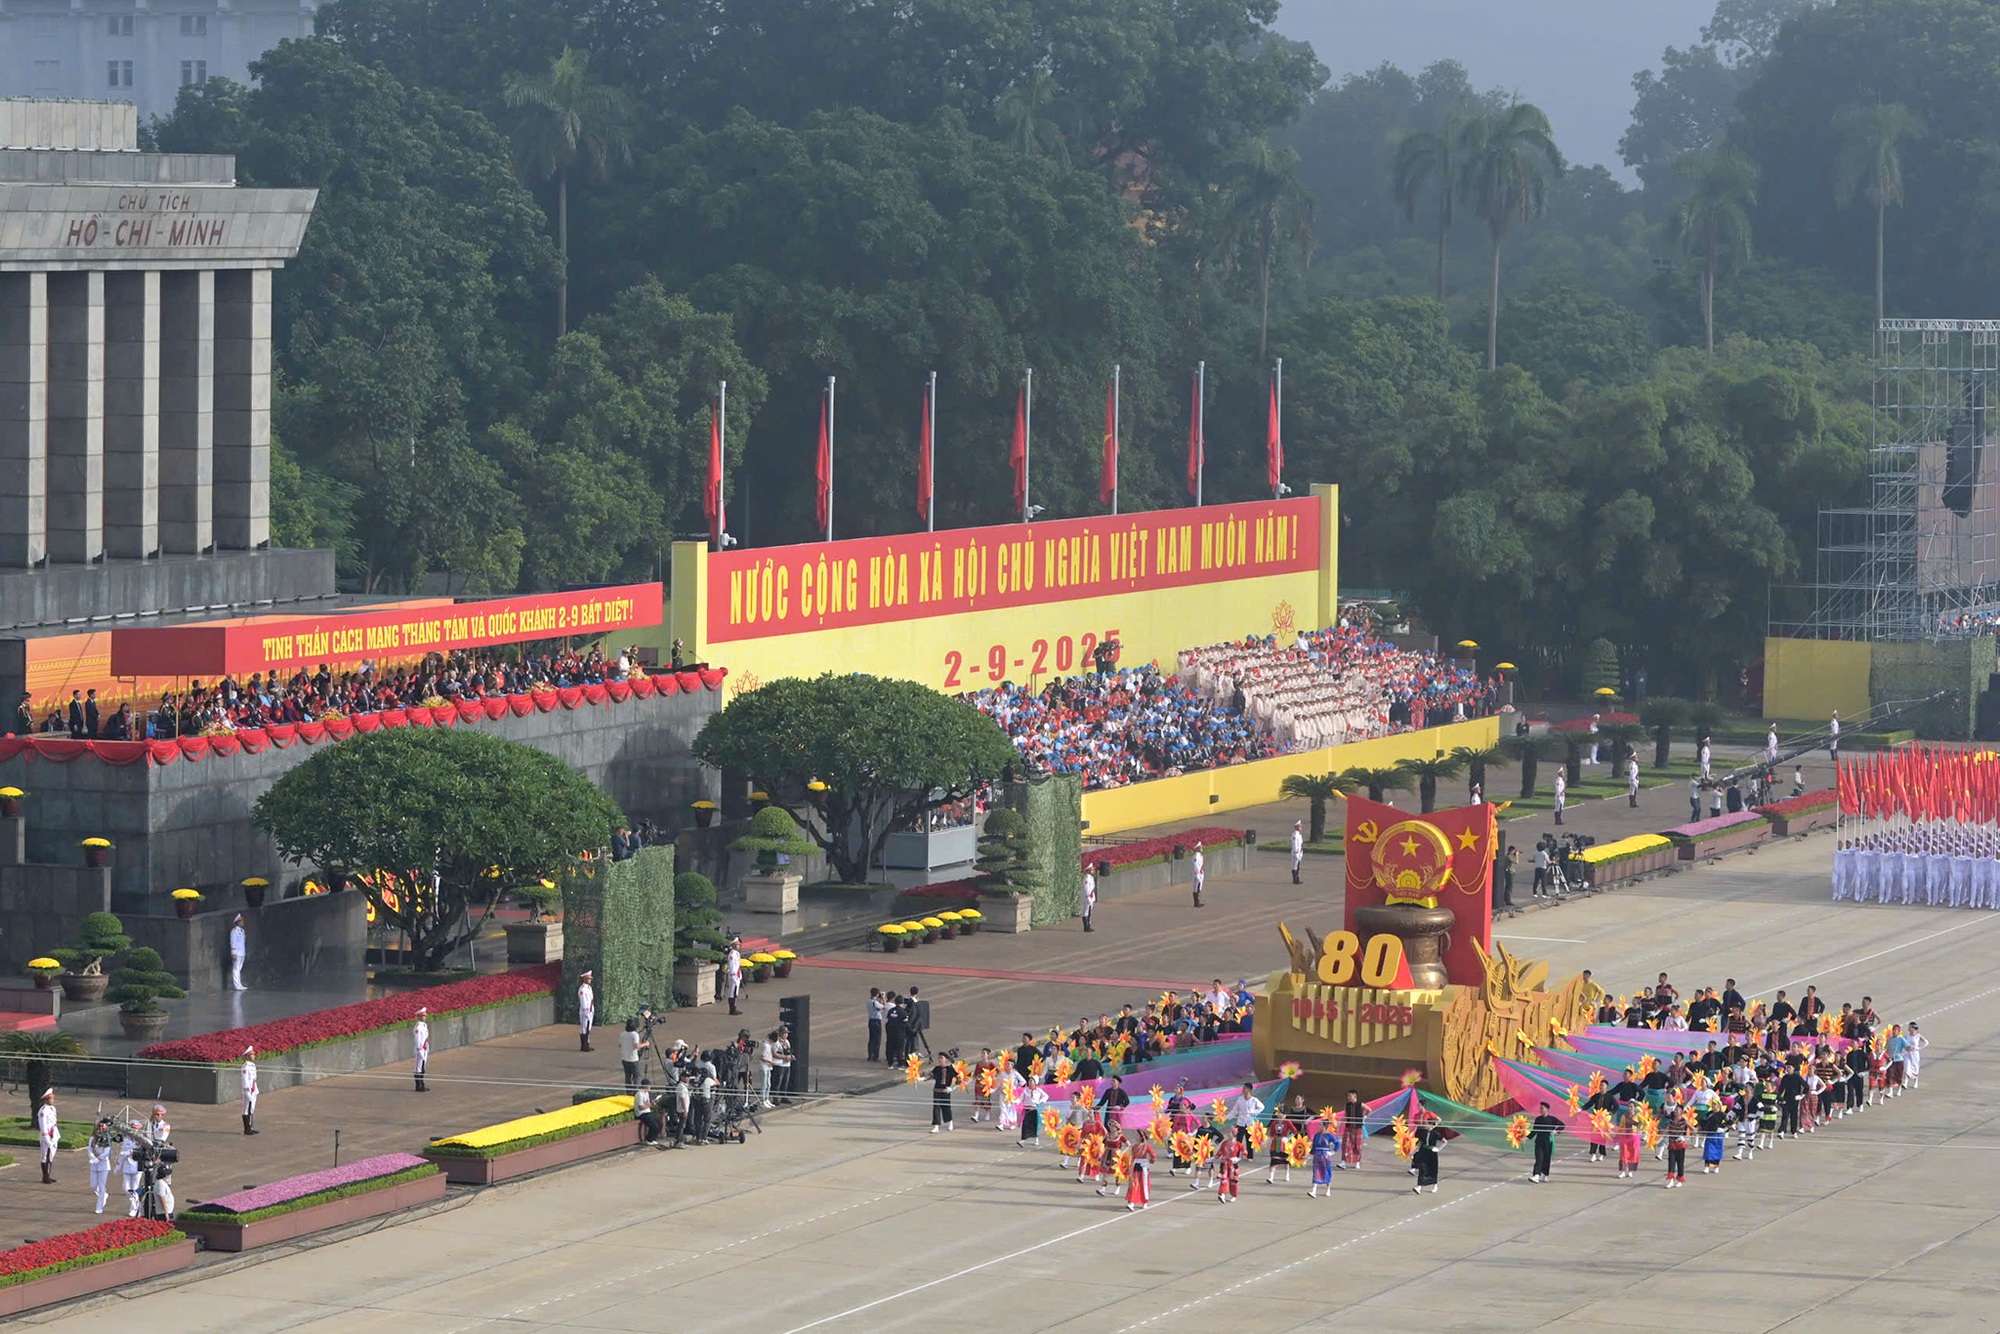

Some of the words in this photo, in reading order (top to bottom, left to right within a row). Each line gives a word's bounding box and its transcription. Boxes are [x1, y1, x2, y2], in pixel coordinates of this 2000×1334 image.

[118, 189, 149, 210] CHỦ
[730, 558, 789, 625] NƯỚC
[801, 553, 858, 625] CỘNG
[869, 547, 908, 608] HÒA
[919, 542, 943, 602] XÃ
[954, 537, 987, 606] HỘI
[998, 530, 1035, 594] CHỦ
[1045, 528, 1101, 588] NGHĨA
[1110, 522, 1148, 588] VIỆT
[1157, 525, 1192, 575] NAM
[1201, 512, 1247, 570] MUÔN
[262, 635, 293, 661] TINH
[296, 625, 329, 657] THẦN
[332, 625, 364, 654] CÁCH
[366, 624, 399, 653] MẠNG
[402, 617, 441, 646] THÁNG
[443, 613, 469, 641] TÁM
[471, 610, 486, 638] VÀ
[488, 605, 517, 638] QUỐC
[519, 604, 556, 633] KHÁNH
[558, 604, 579, 628] 2-9
[581, 596, 602, 626] BẤT
[1317, 930, 1403, 987] 80
[1292, 998, 1338, 1021] 1945
[1361, 1002, 1412, 1027] 2025
